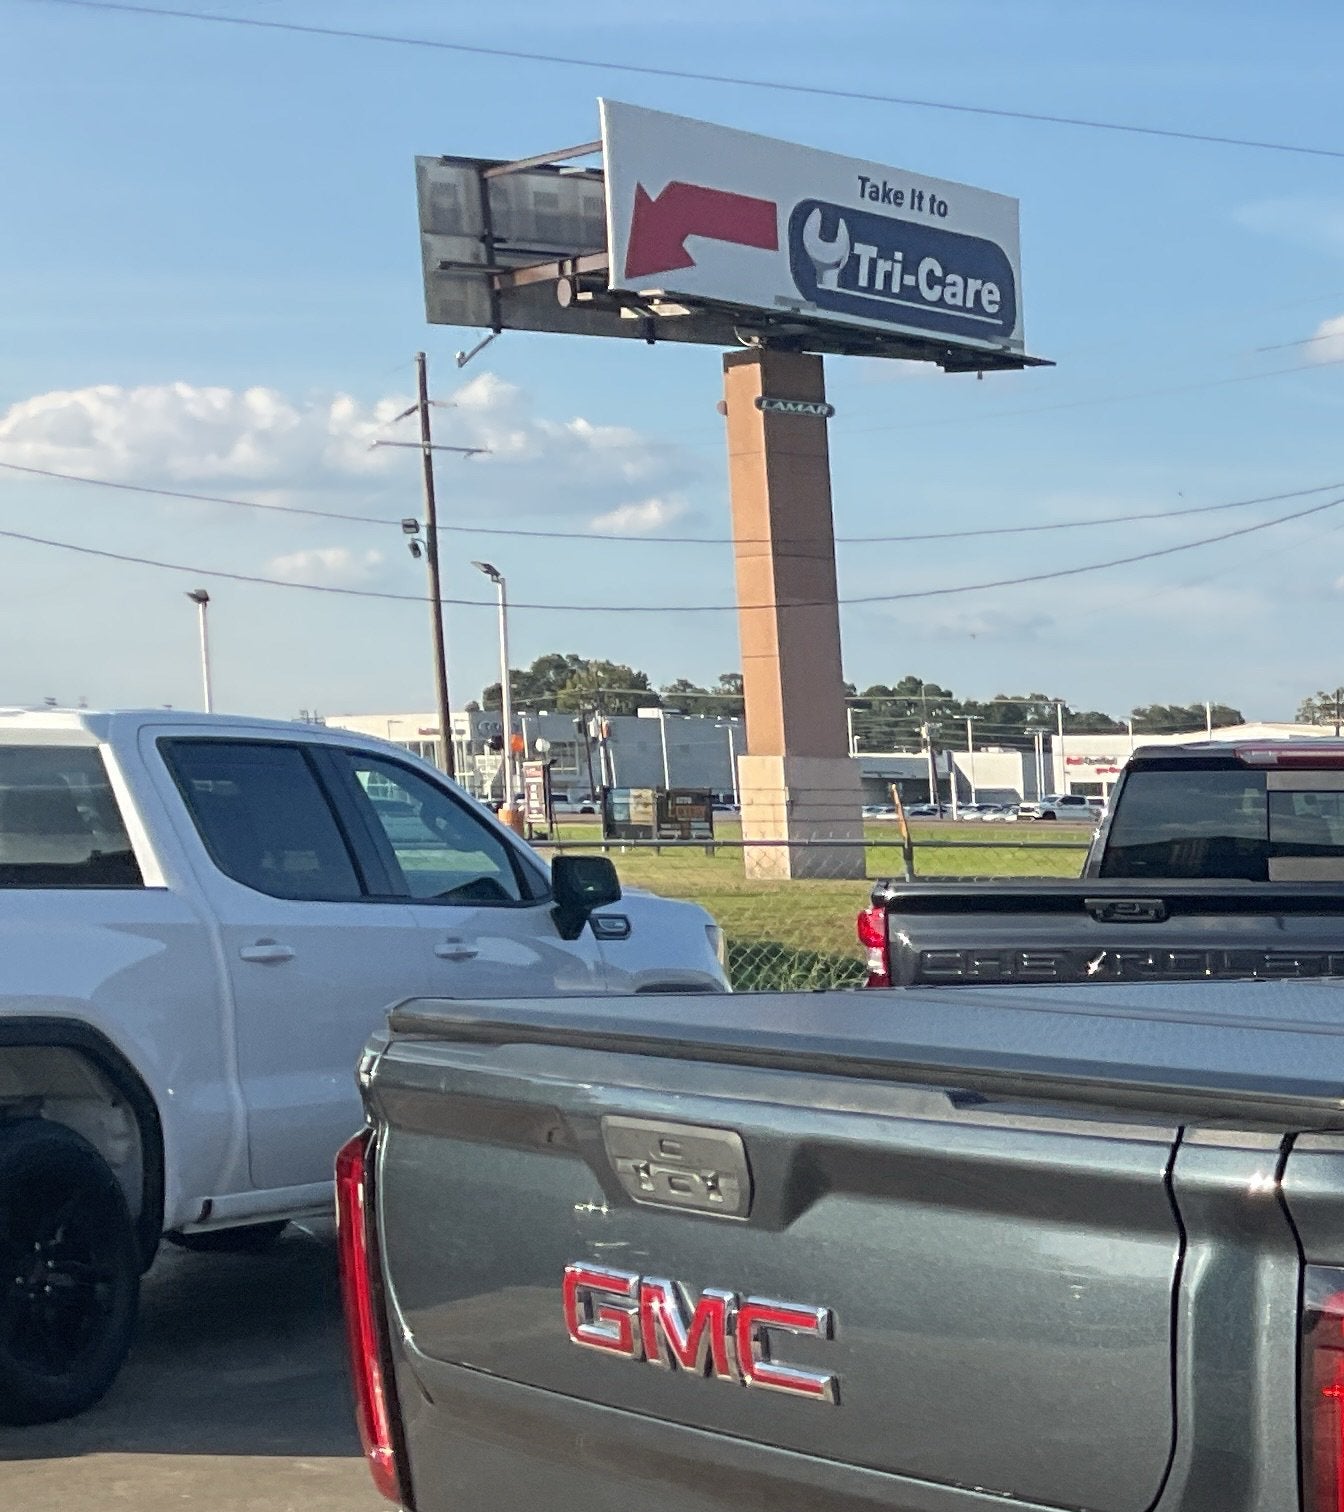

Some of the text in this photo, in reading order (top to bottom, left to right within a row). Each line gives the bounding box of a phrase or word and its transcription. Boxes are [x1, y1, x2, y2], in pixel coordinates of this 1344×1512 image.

[858, 175, 948, 218] Take It to
[853, 242, 1001, 314] Tri-Care
[761, 399, 829, 415] LAMAR
[563, 1261, 842, 1406] GMC
